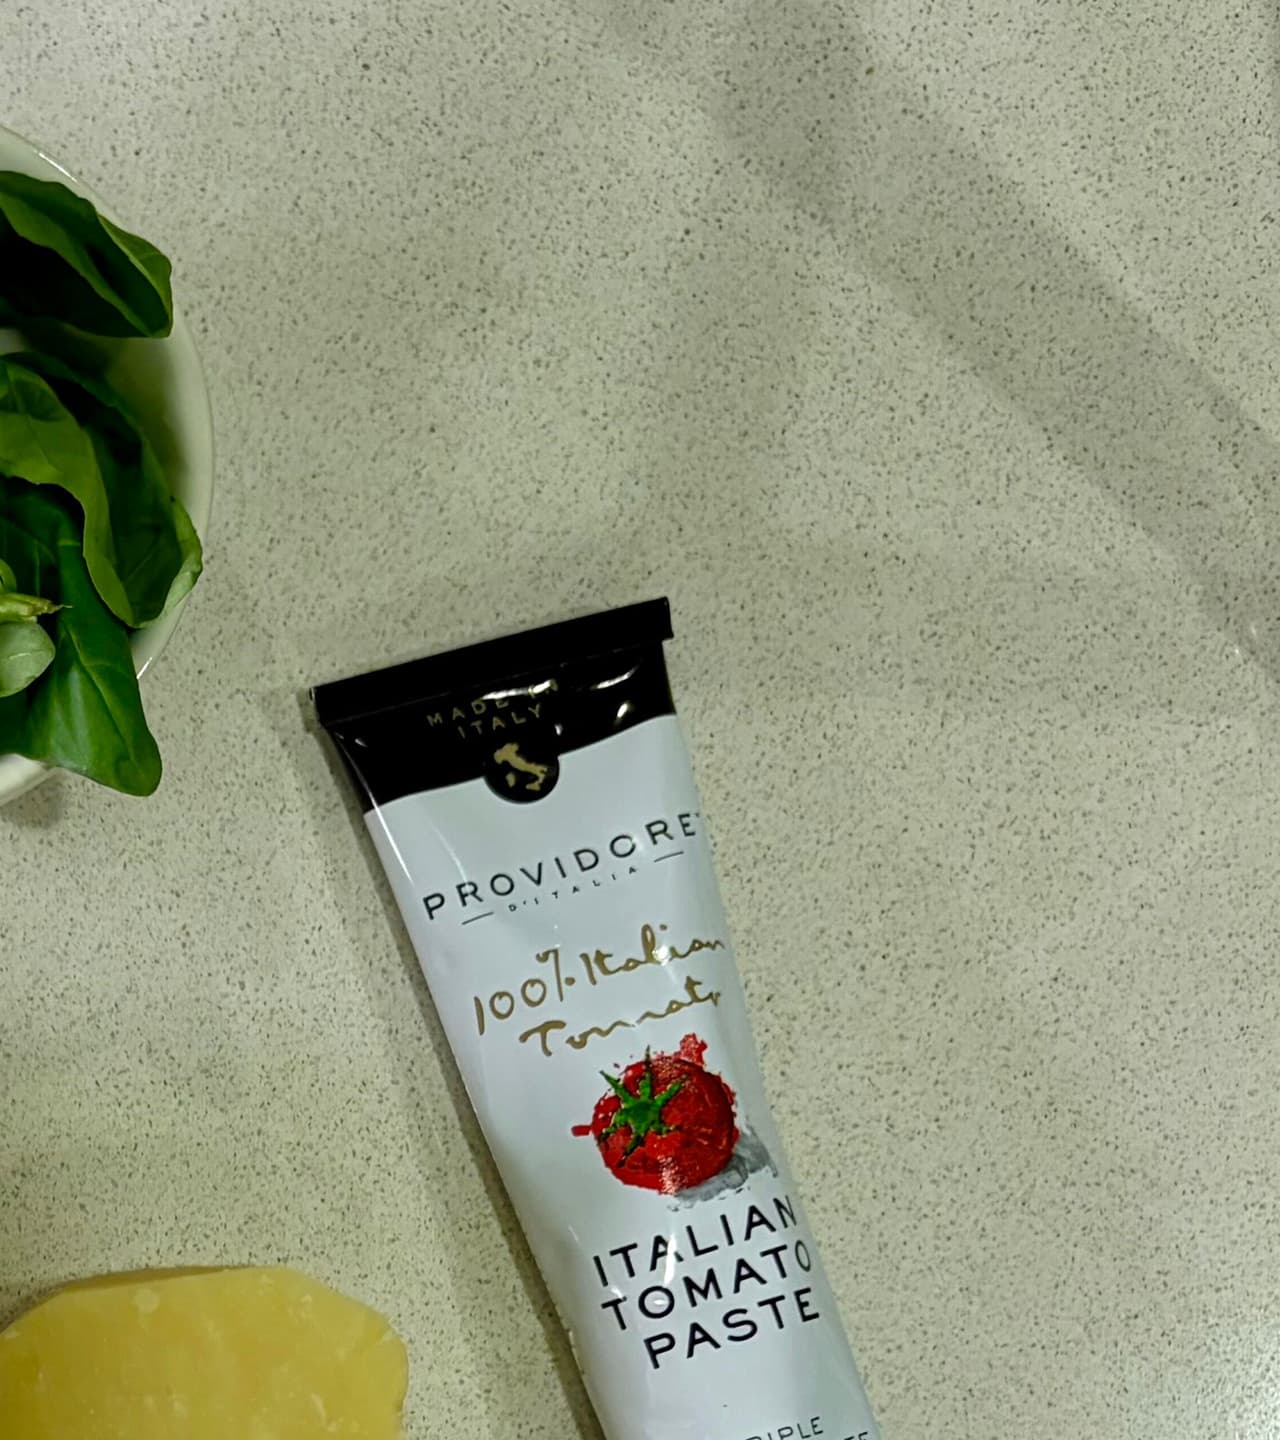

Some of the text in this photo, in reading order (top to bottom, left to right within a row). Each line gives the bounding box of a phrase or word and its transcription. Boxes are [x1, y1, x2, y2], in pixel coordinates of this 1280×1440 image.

[426, 697, 510, 727] MADE
[457, 703, 541, 739] ITALY
[422, 812, 697, 920] PROVIDORE
[508, 866, 638, 913] D'ITALIA
[473, 923, 725, 1036] 100% Italian
[592, 1194, 798, 1288] ITALIAN
[600, 1239, 812, 1331] TOMATO
[643, 1286, 821, 1370] PASTE
